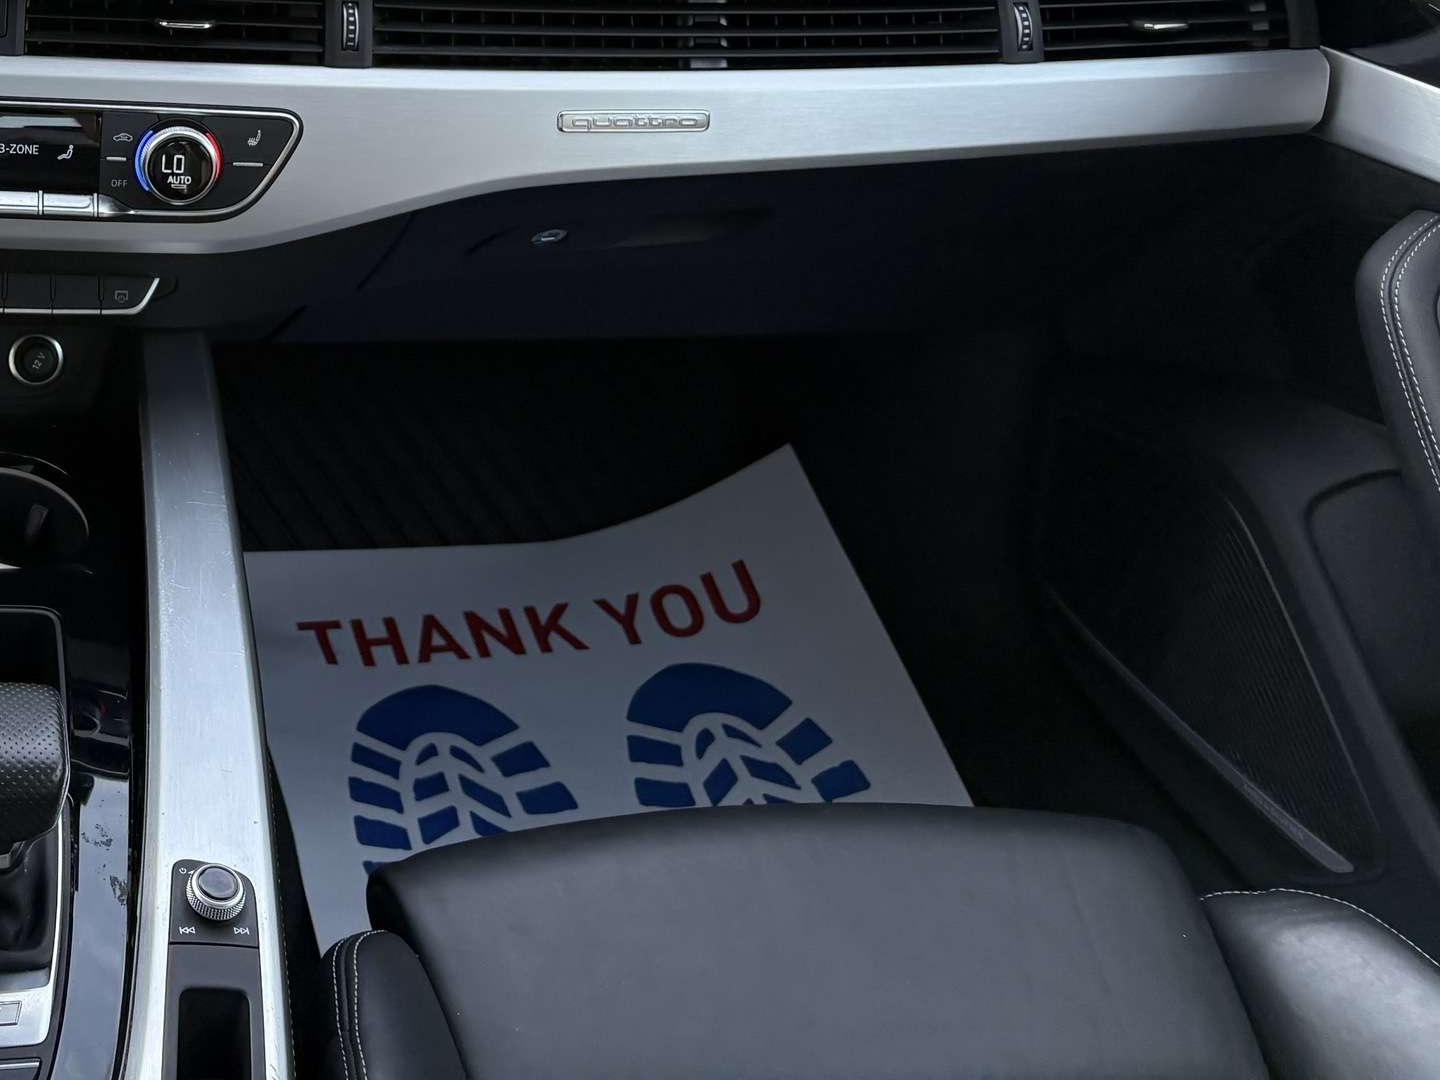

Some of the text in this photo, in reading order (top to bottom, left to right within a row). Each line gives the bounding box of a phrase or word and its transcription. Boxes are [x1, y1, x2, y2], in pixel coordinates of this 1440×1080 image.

[571, 113, 698, 131] quattro
[161, 154, 184, 173] LO
[167, 175, 192, 184] AUTO
[297, 558, 761, 667] THANK YOU
